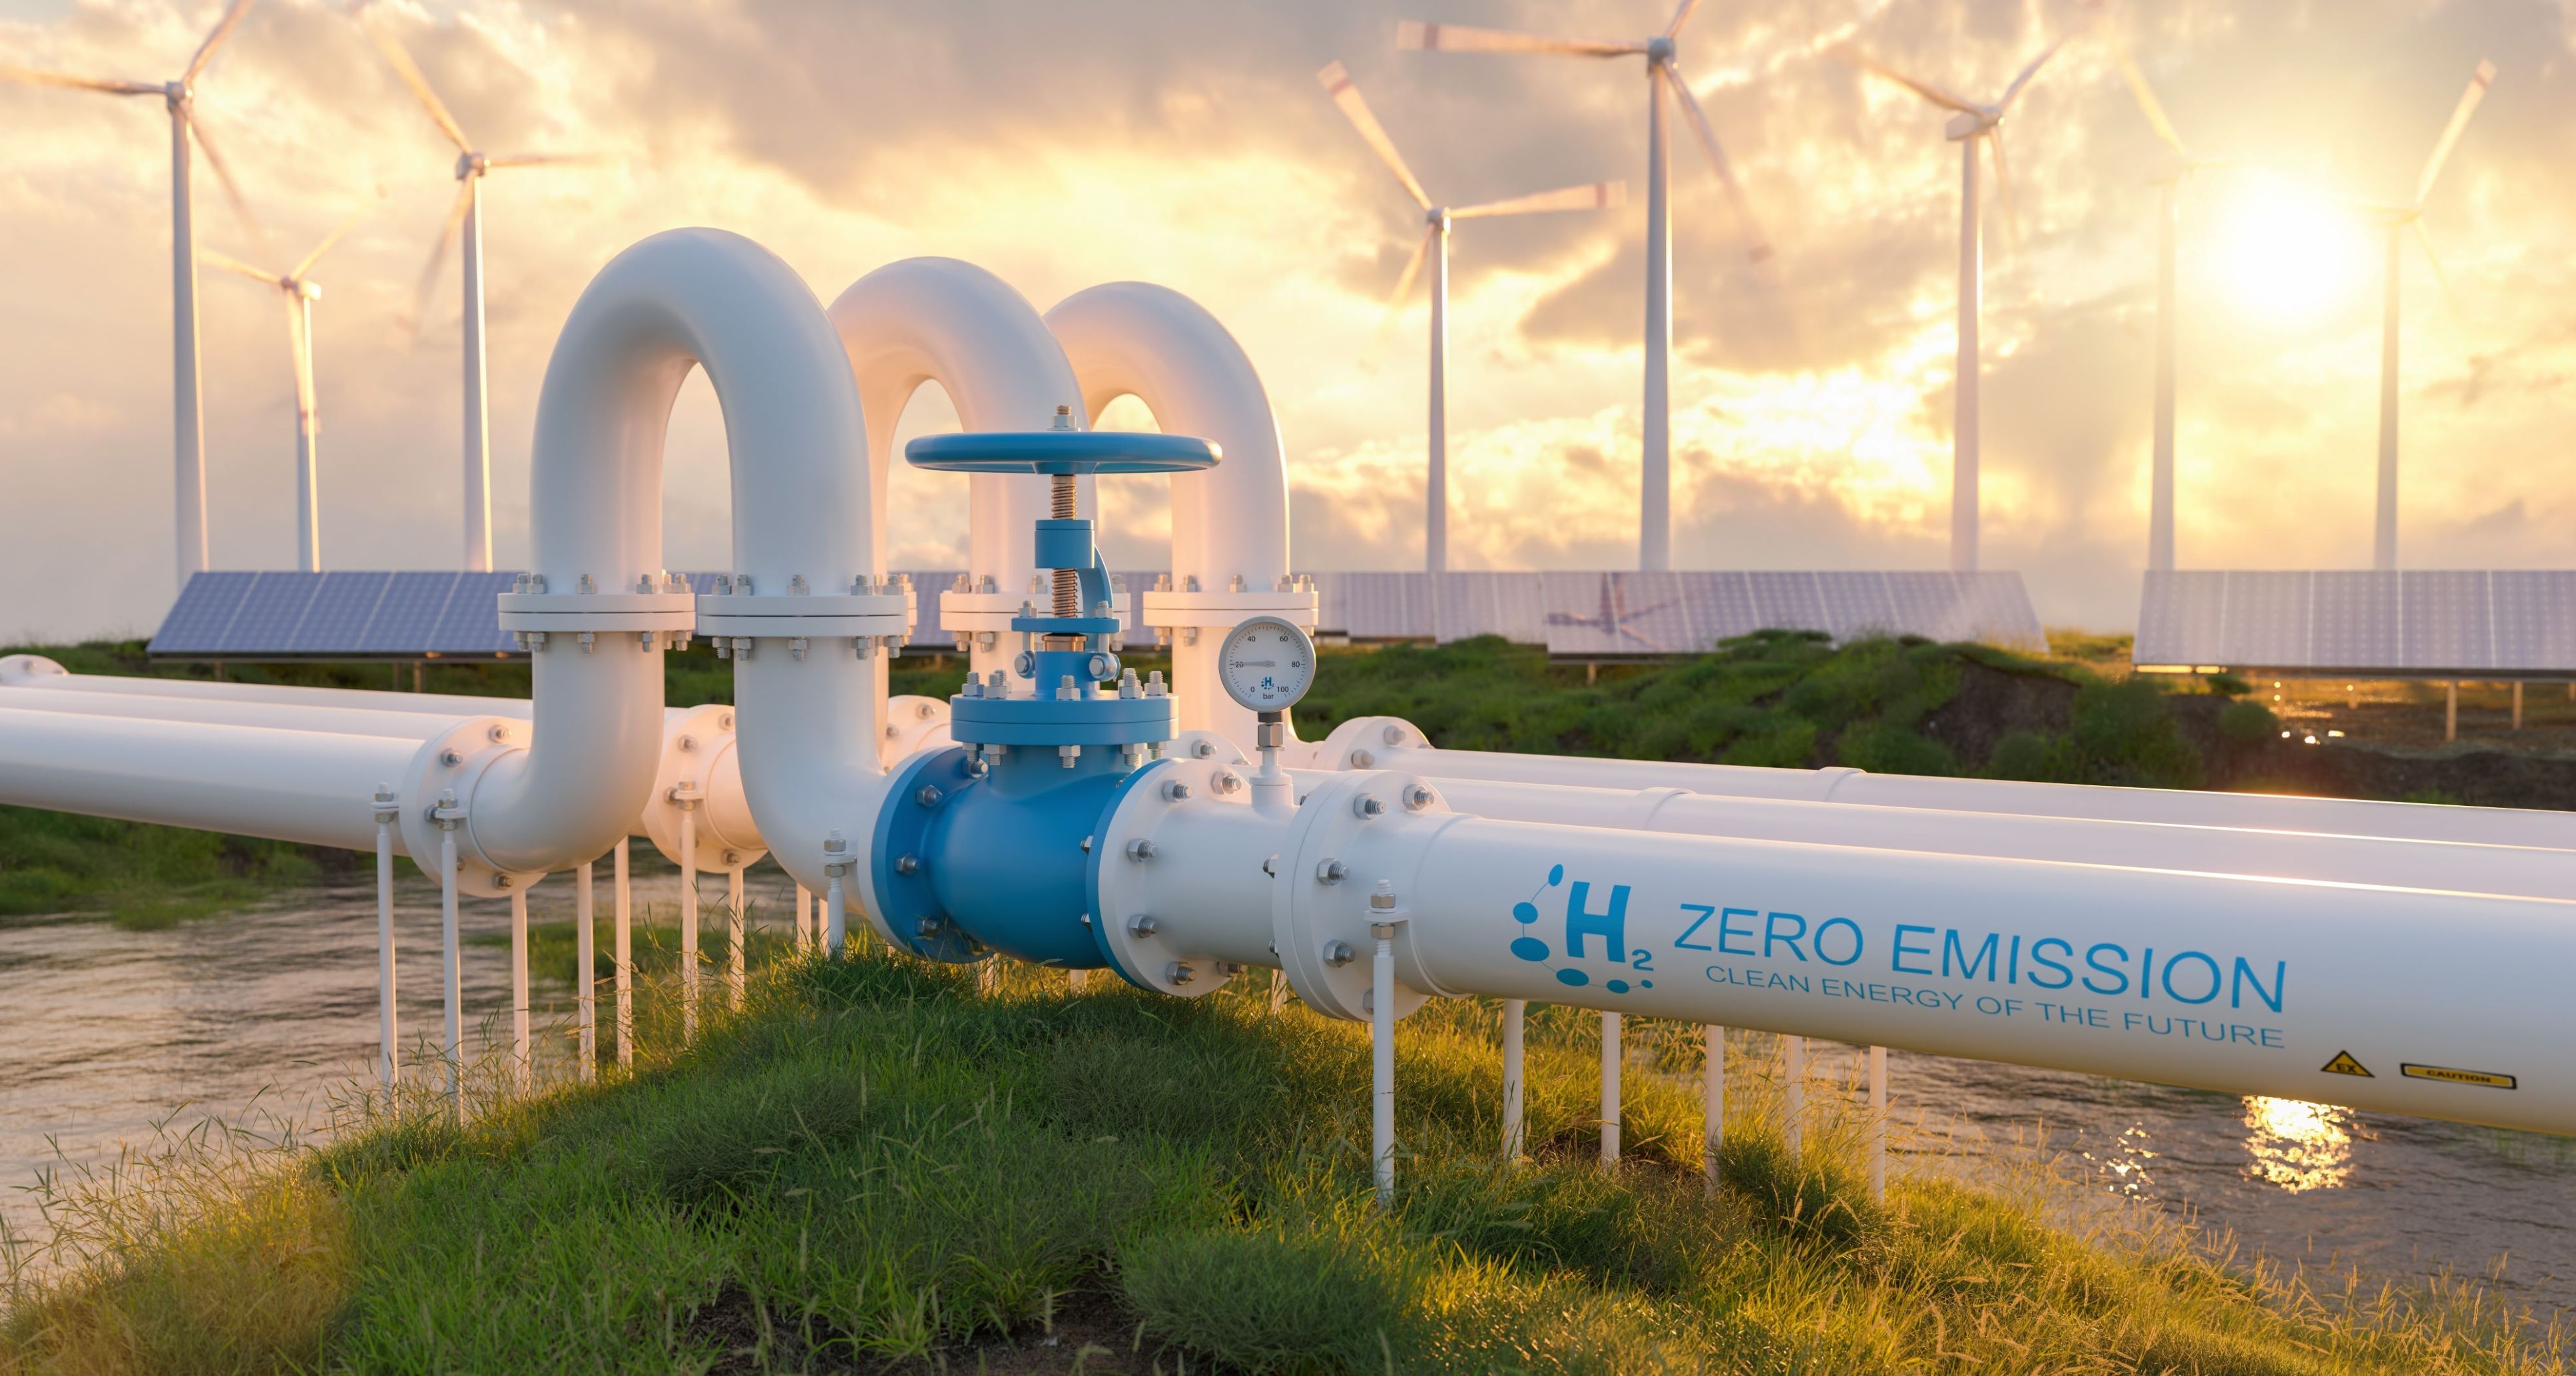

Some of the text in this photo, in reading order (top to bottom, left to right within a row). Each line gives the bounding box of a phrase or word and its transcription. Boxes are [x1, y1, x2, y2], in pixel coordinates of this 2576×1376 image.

[1673, 902, 2287, 1014] ZERO EMISSION
[1704, 965, 2287, 1050] CLEAN ENERGY OF THE FUTURE
[2336, 1064, 2357, 1072] EX
[2427, 1070, 2491, 1083] CAUTION
